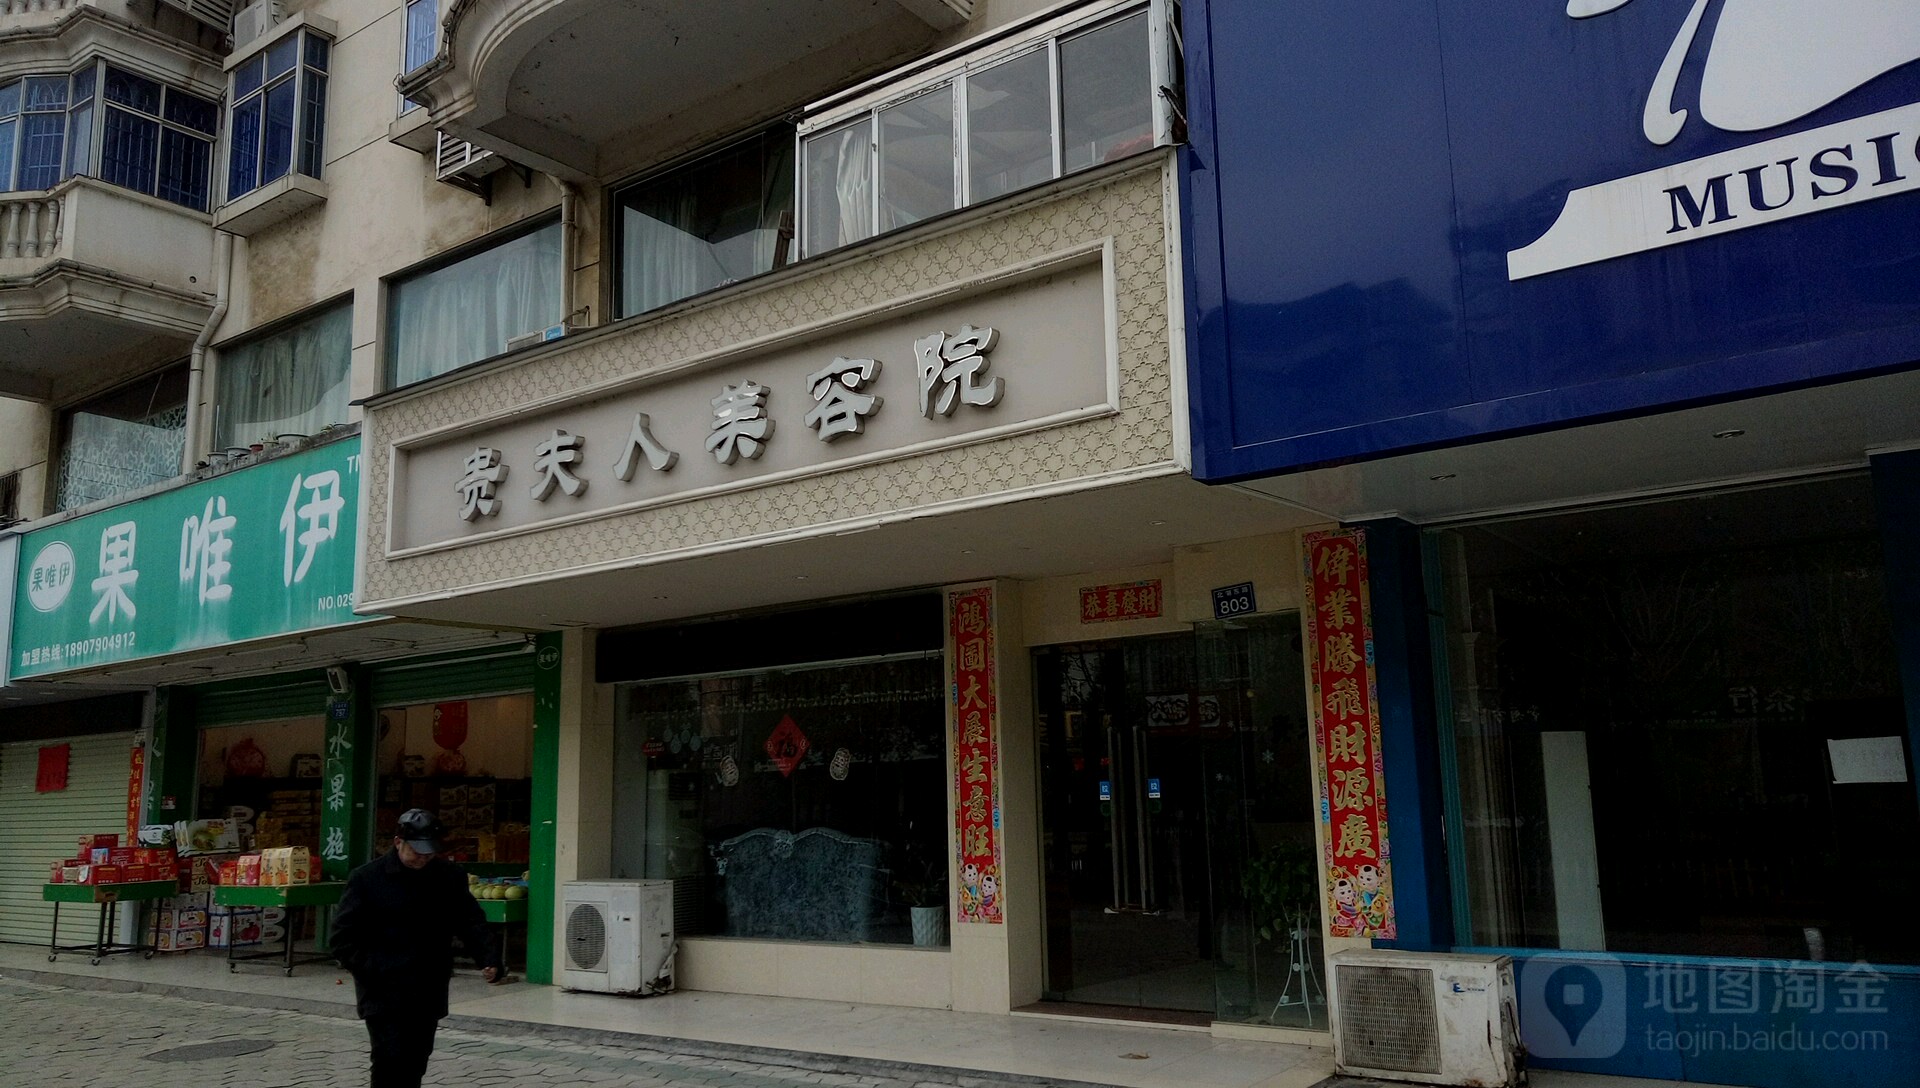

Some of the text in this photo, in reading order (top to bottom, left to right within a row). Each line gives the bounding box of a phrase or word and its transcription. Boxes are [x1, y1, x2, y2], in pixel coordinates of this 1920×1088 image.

[1663, 133, 1920, 234] MUSI
[454, 323, 1006, 522] 贵夫人美容院
[32, 561, 71, 593] 果唯伊
[89, 470, 346, 625] 果唯伊
[1085, 586, 1157, 618] 恭喜發財
[1220, 596, 1250, 614] 803
[322, 722, 352, 881] 水果超
